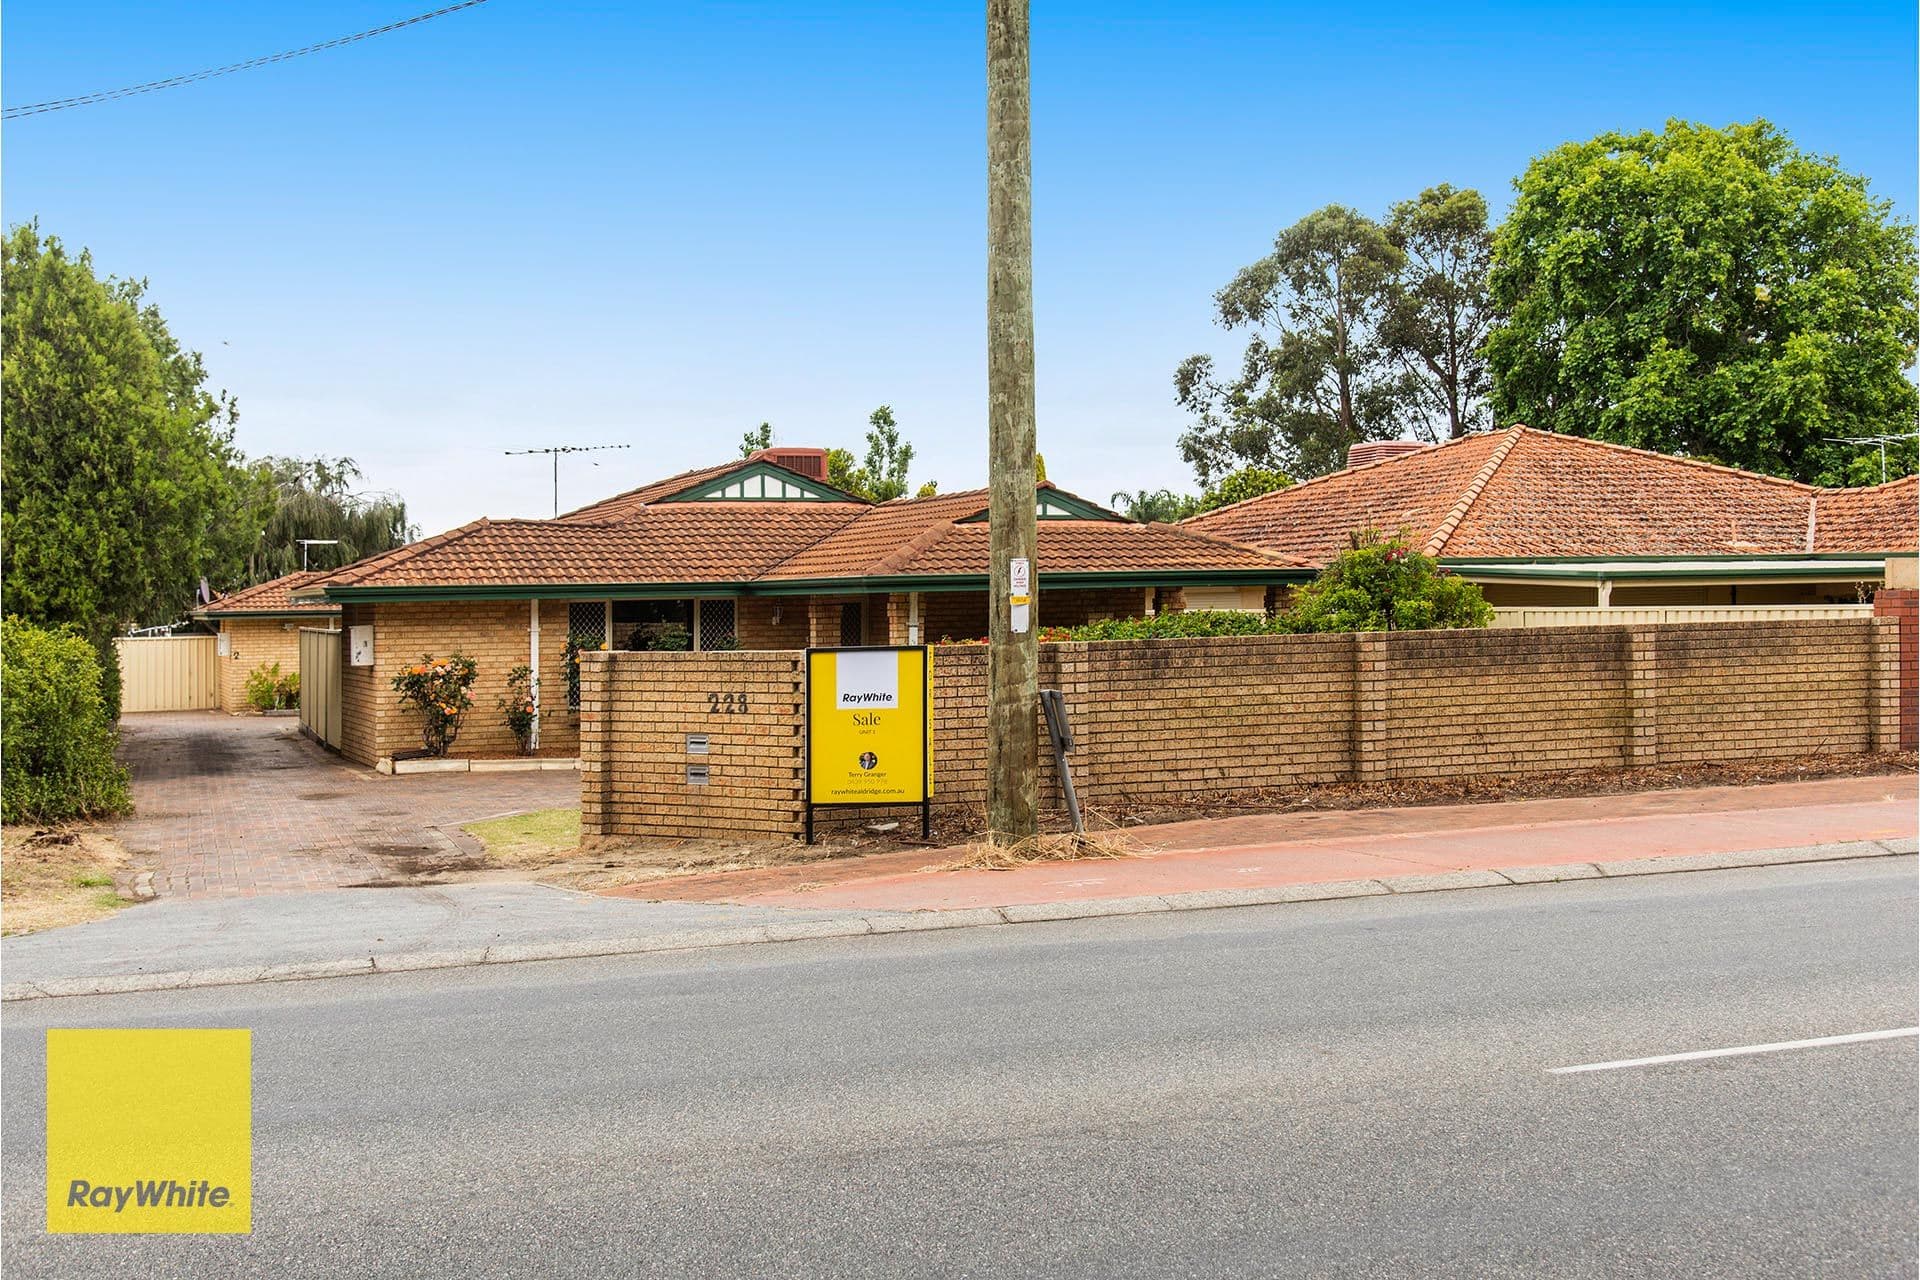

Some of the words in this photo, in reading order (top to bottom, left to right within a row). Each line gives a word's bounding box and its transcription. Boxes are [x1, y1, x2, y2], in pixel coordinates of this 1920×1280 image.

[708, 693, 748, 714] 228
[842, 692, 893, 704] RayWhite
[852, 712, 881, 726] Sale
[848, 771, 863, 779] Terry
[863, 771, 887, 779] Granger
